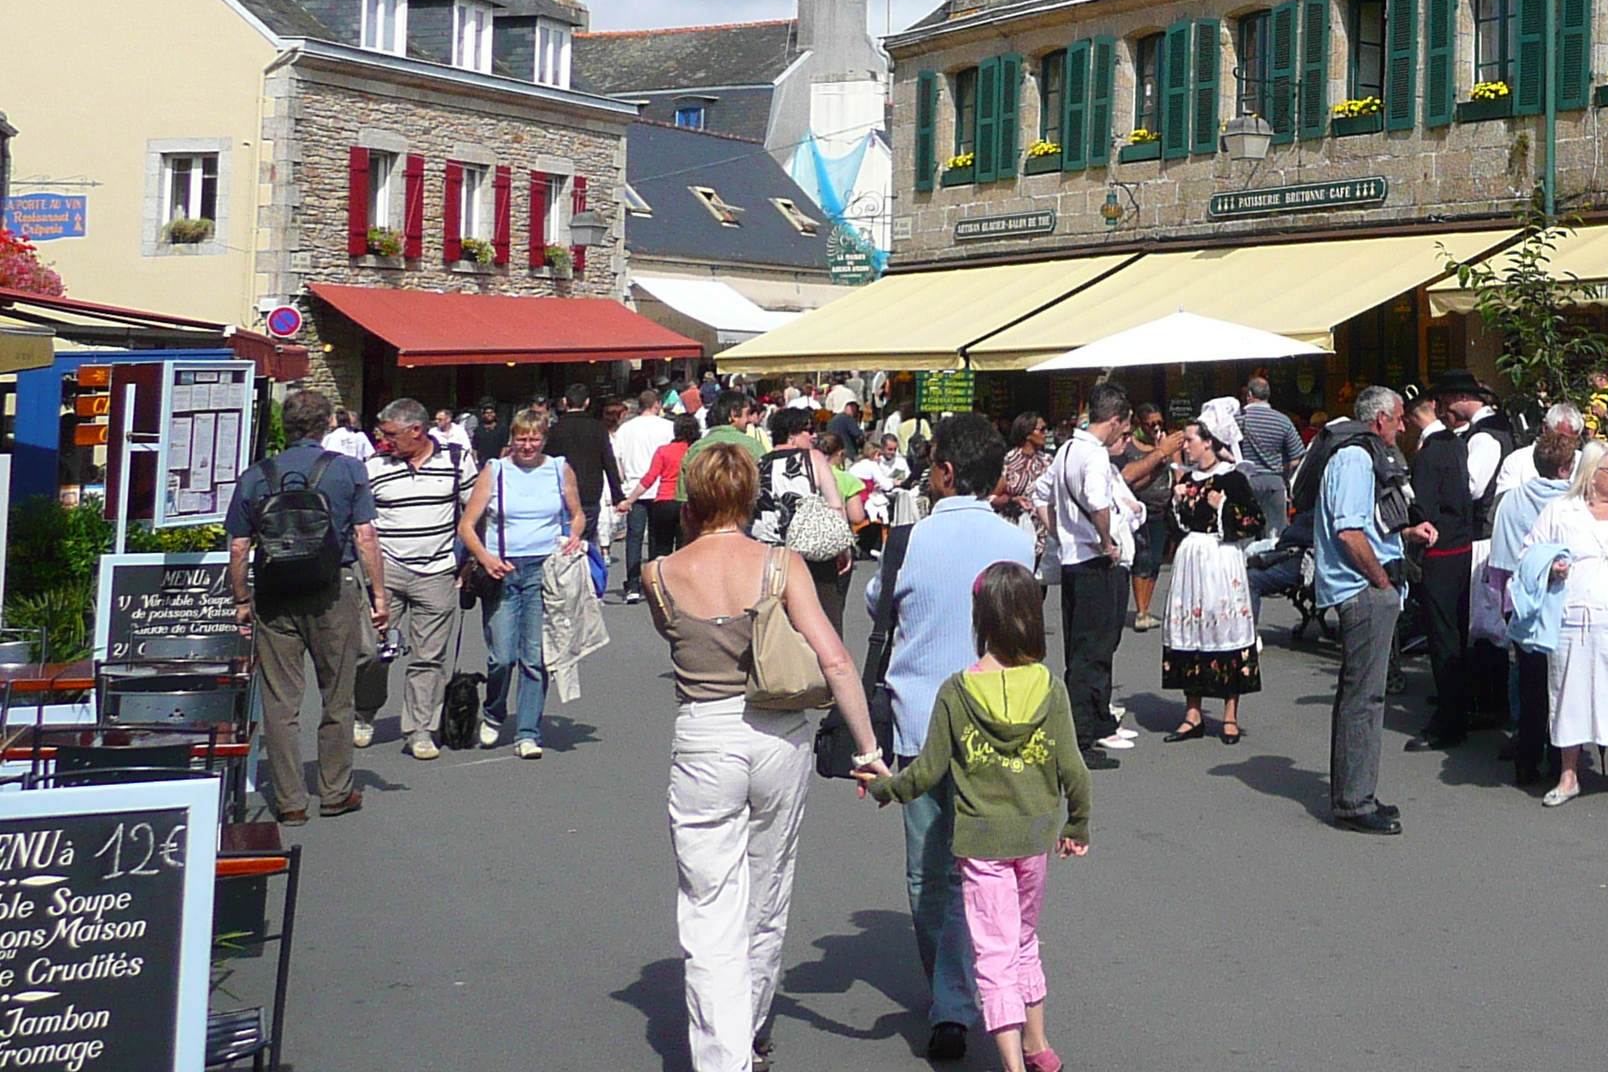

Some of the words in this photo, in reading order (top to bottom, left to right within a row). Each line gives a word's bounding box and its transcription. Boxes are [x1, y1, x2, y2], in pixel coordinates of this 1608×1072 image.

[1238, 193, 1281, 208] PATISSERIE
[1285, 188, 1326, 204] BRETONNE
[160, 569, 207, 587] MENU
[131, 608, 146, 619] de
[147, 608, 199, 622] poissons
[94, 821, 188, 880] 12€
[47, 887, 133, 921] Soupe
[38, 916, 147, 951] Maison
[27, 952, 145, 986] Crudités
[0, 1004, 111, 1039] Jambon
